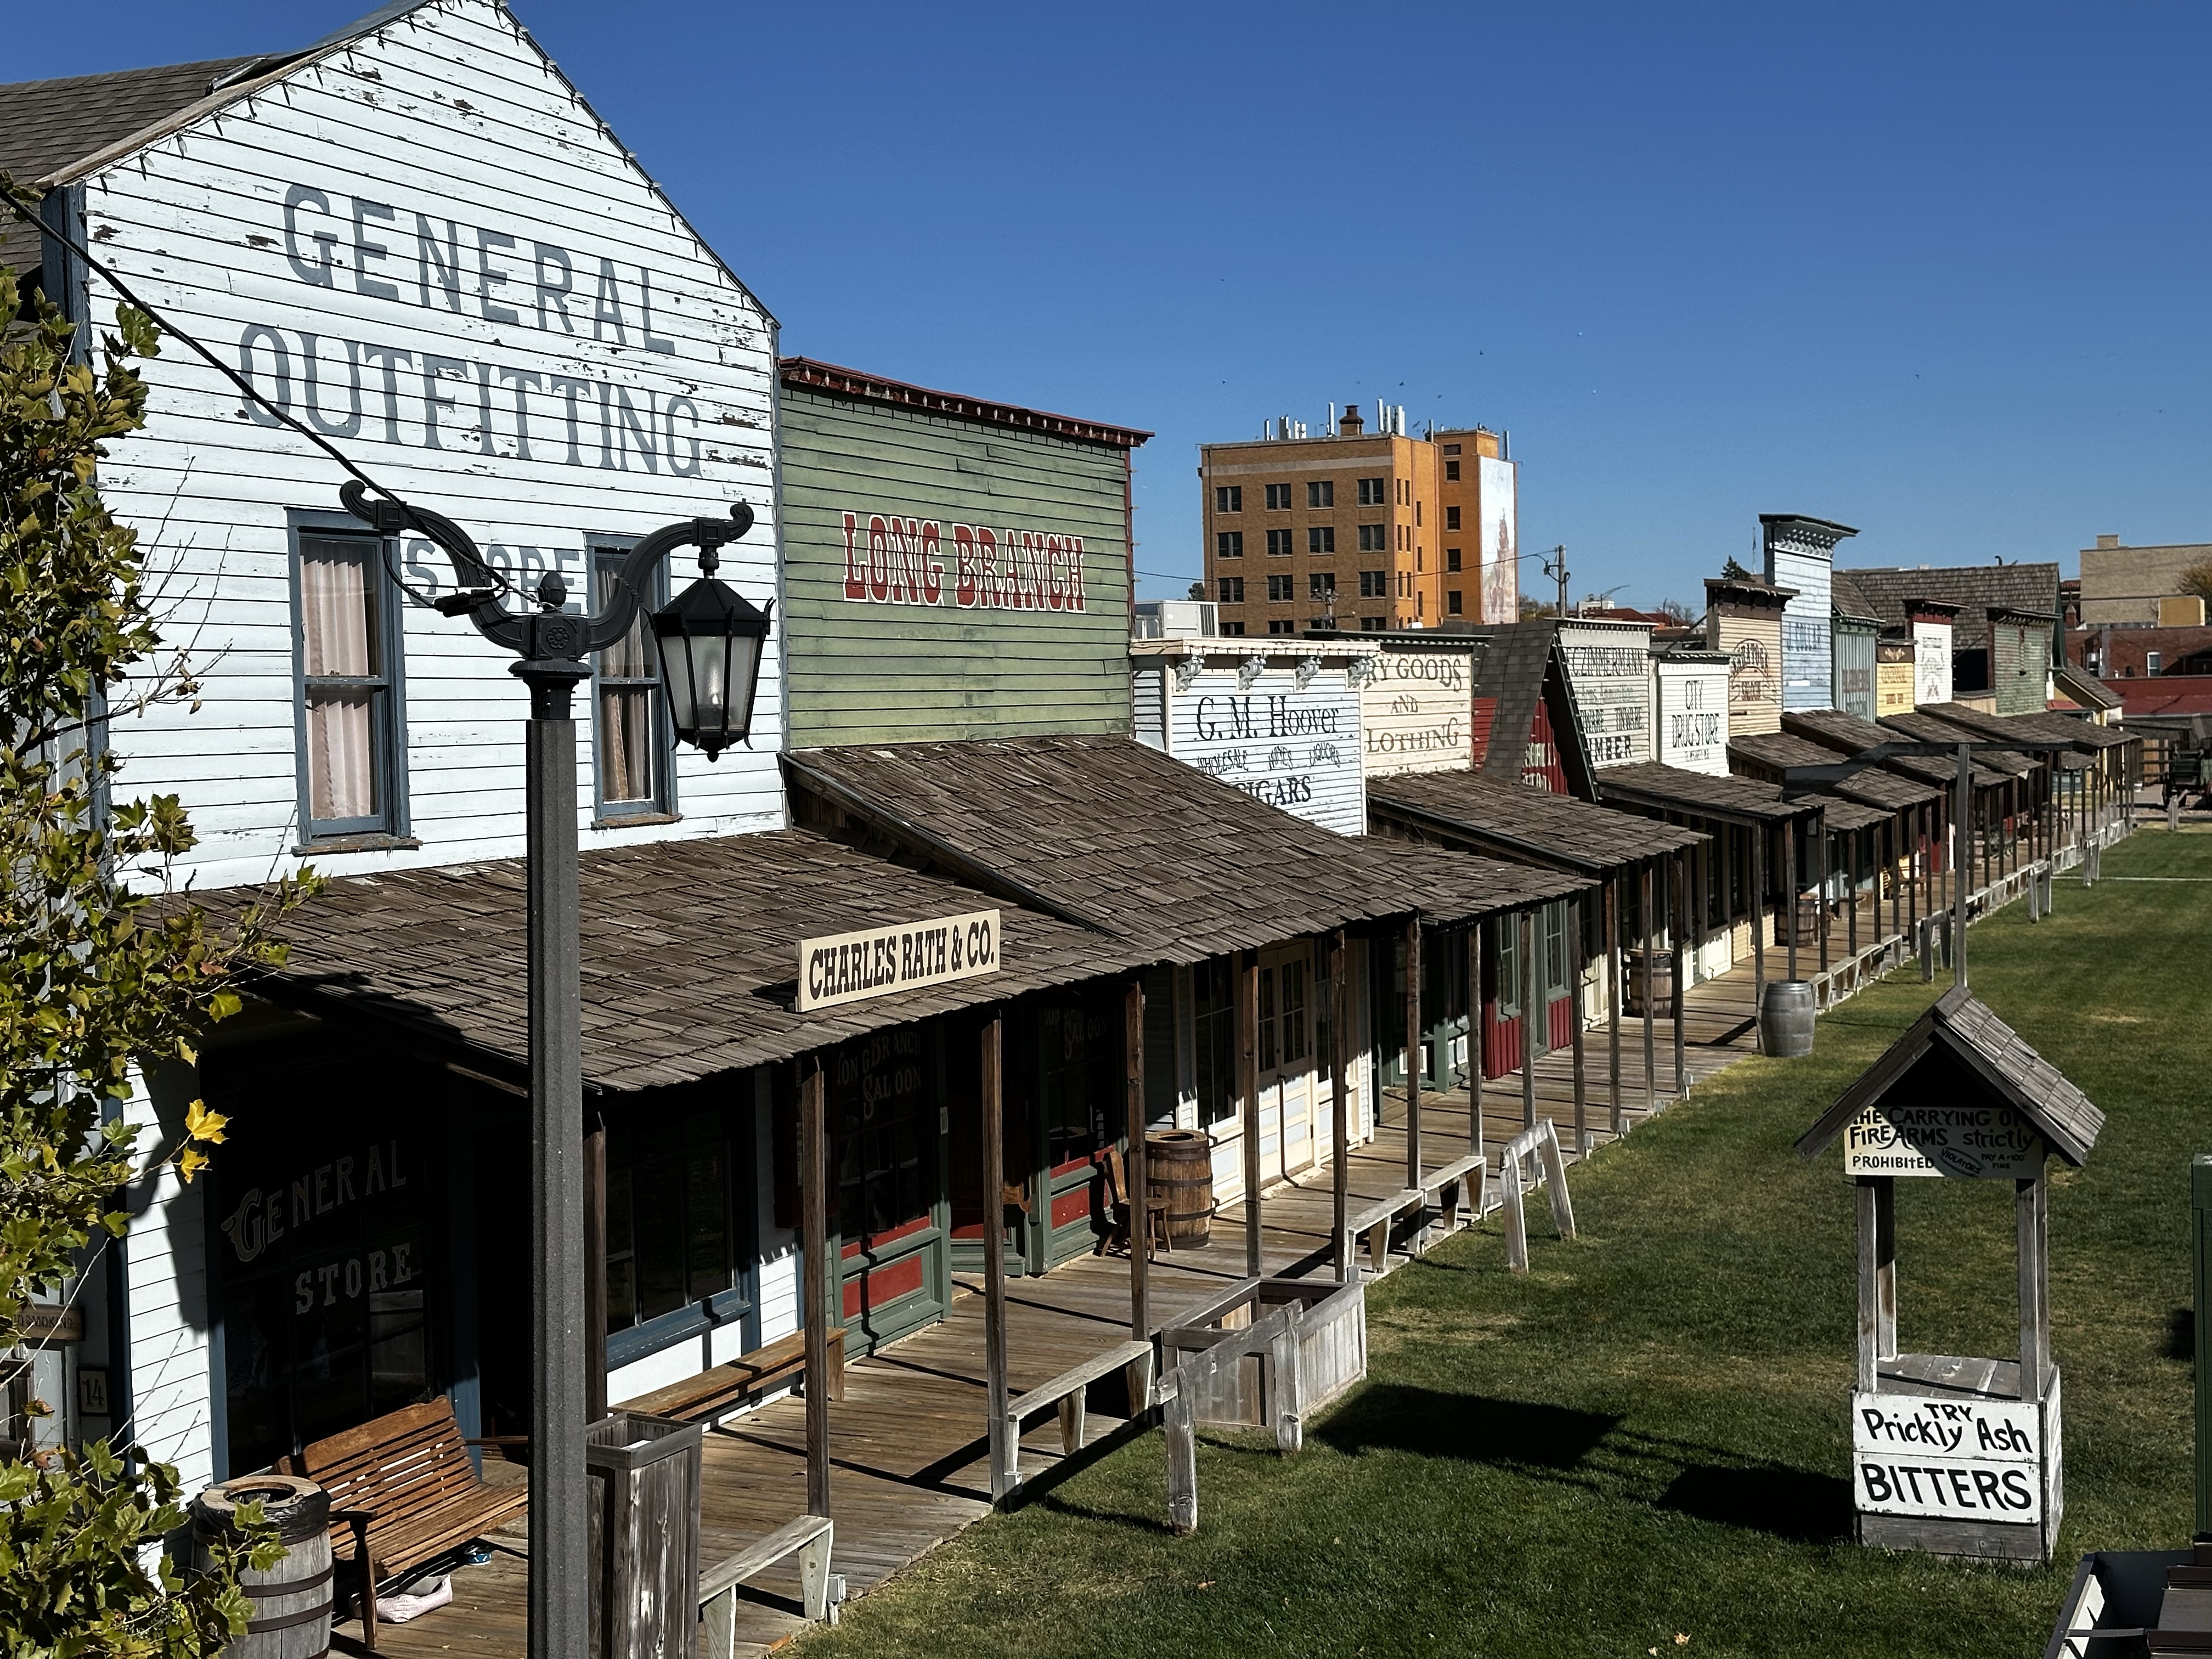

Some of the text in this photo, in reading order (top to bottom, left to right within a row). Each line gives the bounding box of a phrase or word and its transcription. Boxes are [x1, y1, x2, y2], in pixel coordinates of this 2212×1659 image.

[283, 182, 676, 356] GENERAL
[239, 321, 703, 479] OUTFITTING
[406, 539, 582, 616] SORE
[842, 511, 1087, 614] LONG BRANCH
[1364, 658, 1462, 692] RY GOODS
[1267, 695, 1339, 738] Hoover
[1391, 695, 1418, 713] AND
[1363, 718, 1459, 753] LOTHING
[1197, 749, 1249, 776] WHOLESALE
[1268, 745, 1294, 771] WINES
[809, 919, 994, 1000] CHARLES RATH & CO.
[1064, 1015, 1107, 1060] SALOON
[862, 1065, 922, 1120] SALOON
[1888, 1107, 1990, 1127] CARRYING
[1962, 1128, 2036, 1153] strictly
[1981, 1153, 1996, 1161] PAY
[221, 1139, 407, 1262] GENERAL
[296, 1242, 412, 1315] STORE
[82, 1378, 104, 1406] 14
[1923, 1403, 1973, 1422] TRY
[1861, 1408, 2033, 1453] Prickly Ash
[1860, 1463, 2032, 1510] BITTERS
